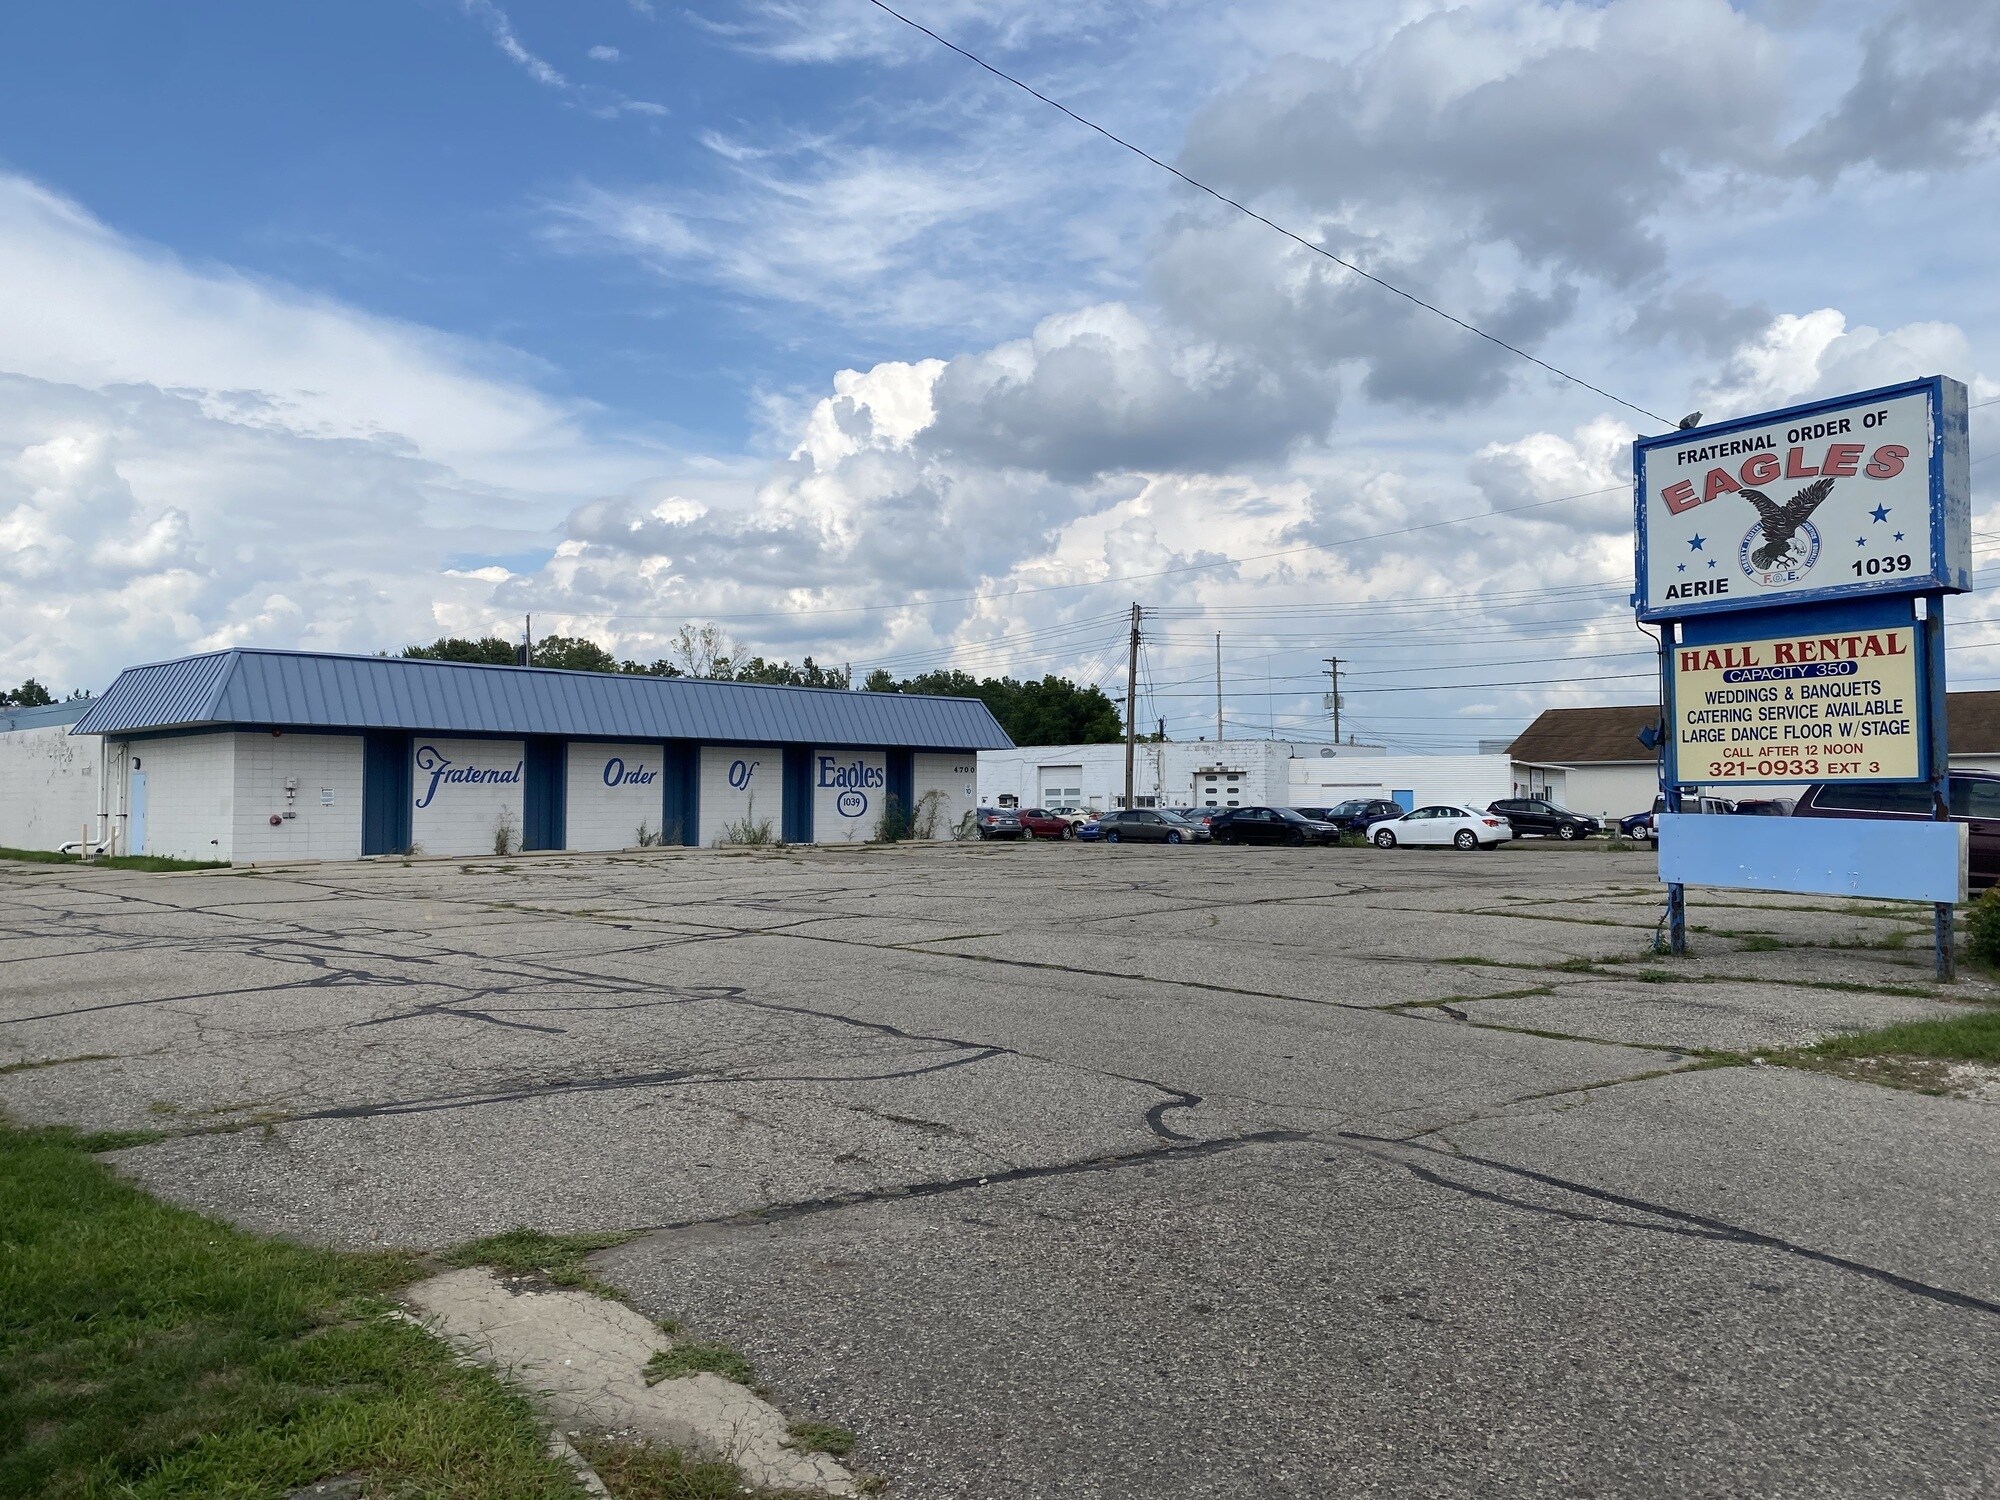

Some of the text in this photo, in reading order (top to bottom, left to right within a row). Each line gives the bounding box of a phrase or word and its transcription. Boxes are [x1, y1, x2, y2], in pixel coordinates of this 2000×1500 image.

[1678, 410, 1888, 466] FRATERNAL ORDER OF
[1660, 444, 1910, 516] EAGLES
[1665, 554, 1912, 600] AERIE 1039
[1680, 633, 1908, 672] HALL RENTAL
[1730, 662, 1850, 682] CAPACITY 350
[1705, 680, 1881, 705] WEDDINGS & BANQUETS
[1687, 699, 1903, 725] CATERING SERVICE AVAILABLE
[1682, 719, 1910, 743] LARGE DANCE FLOOR W/STAGE
[1723, 743, 1864, 758] CALL AFTER 12 NOON
[1709, 759, 1880, 776] 321-0933 EXT 3
[415, 745, 884, 817] Fraternal Order Of Eagles
[843, 797, 860, 807] 1039
